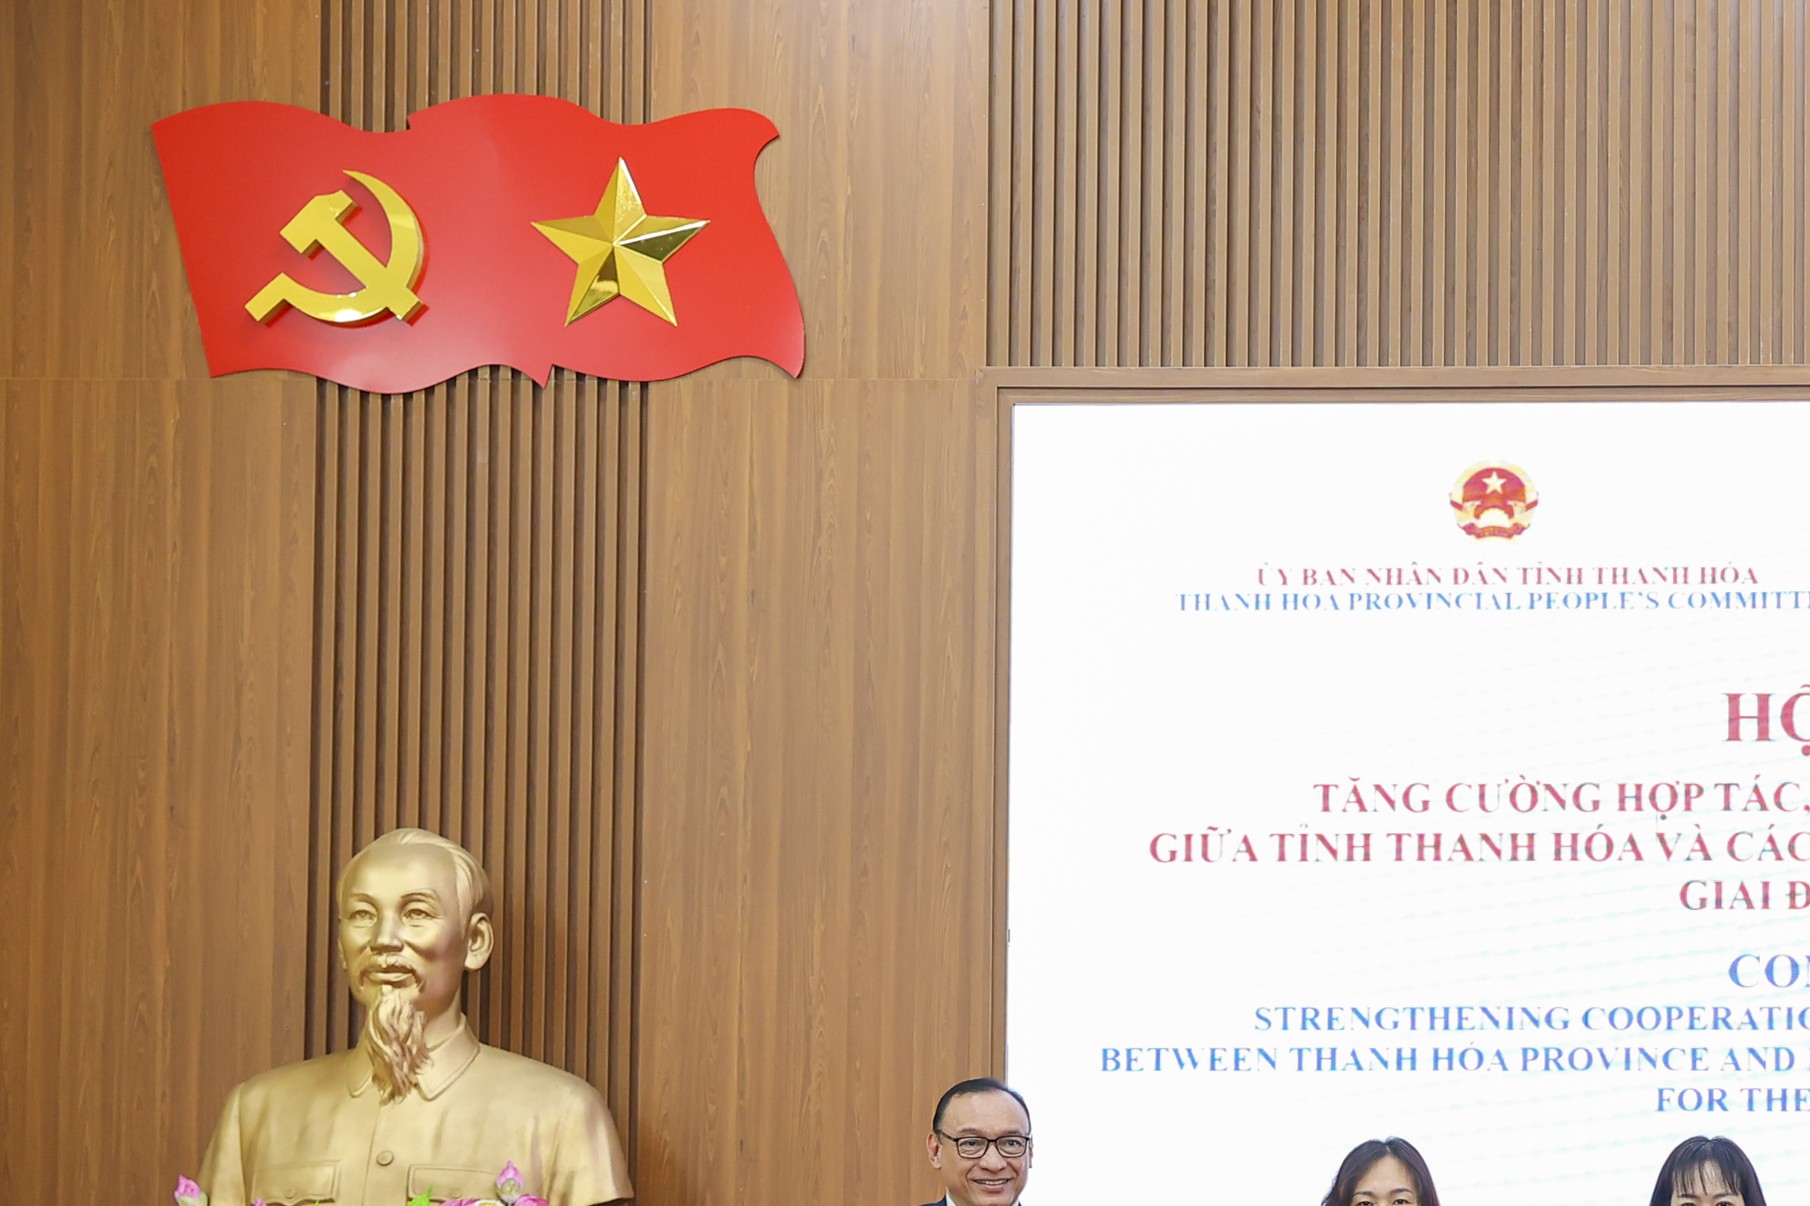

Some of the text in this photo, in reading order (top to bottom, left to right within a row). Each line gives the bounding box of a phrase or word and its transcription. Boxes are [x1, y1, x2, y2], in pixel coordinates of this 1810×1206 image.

[1302, 568, 1356, 585] BAN
[1366, 561, 1442, 585] NHÂN
[1451, 561, 1508, 585] DÂN
[1593, 567, 1690, 585] THANH
[1699, 561, 1759, 585] HÓA
[1175, 592, 1273, 611] THANH
[1349, 591, 1521, 611] PROVINCIAL
[1313, 776, 1432, 813] TĂNG
[1445, 775, 1602, 813] CƯỜNG
[1616, 779, 1705, 820] HỢP
[1149, 826, 1259, 863] GIỮA
[1269, 823, 1373, 862] TỈNH
[1386, 832, 1537, 862] THANH
[1552, 823, 1643, 862] HÓA
[1655, 824, 1712, 861] VÀ
[1679, 881, 1772, 910] GIAI
[1254, 1006, 1571, 1032] STRENGTHENING
[1100, 1047, 1278, 1073] BETWEEN
[1289, 1047, 1418, 1073] THANH
[1432, 1040, 1510, 1073] HÓA
[1520, 1047, 1710, 1072] PROVINCE
[1719, 1047, 1796, 1072] AND
[1656, 1087, 1730, 1113] FOR
